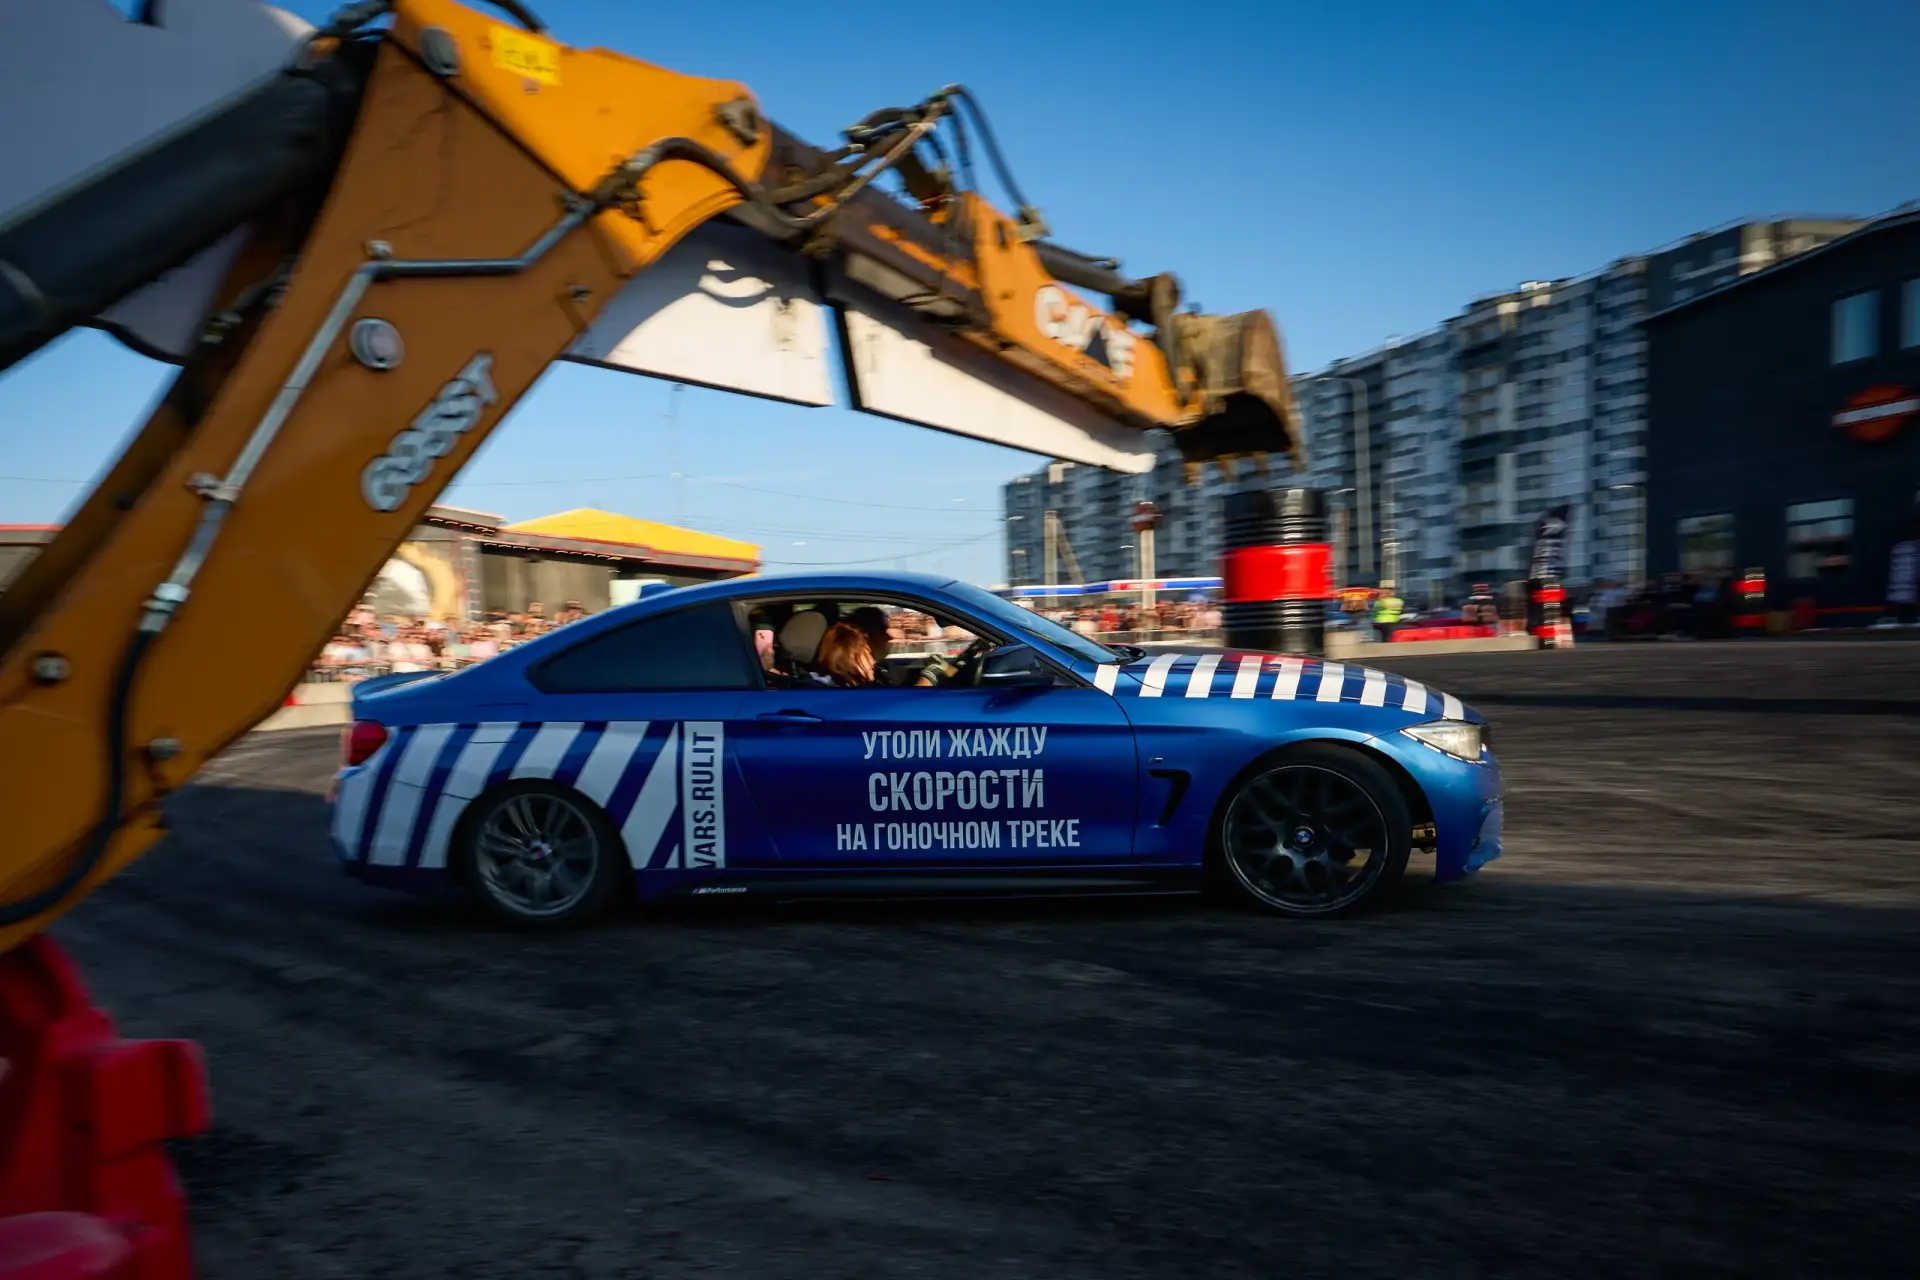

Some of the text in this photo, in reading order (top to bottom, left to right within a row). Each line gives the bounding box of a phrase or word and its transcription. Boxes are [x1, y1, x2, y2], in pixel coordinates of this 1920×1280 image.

[862, 726, 1048, 760] УТОЛИ ЖАЖДУ
[868, 769, 1045, 812] СКОРОСТИ
[836, 819, 1081, 851] НА ГОНОЧНОМ ТРЕКЕ
